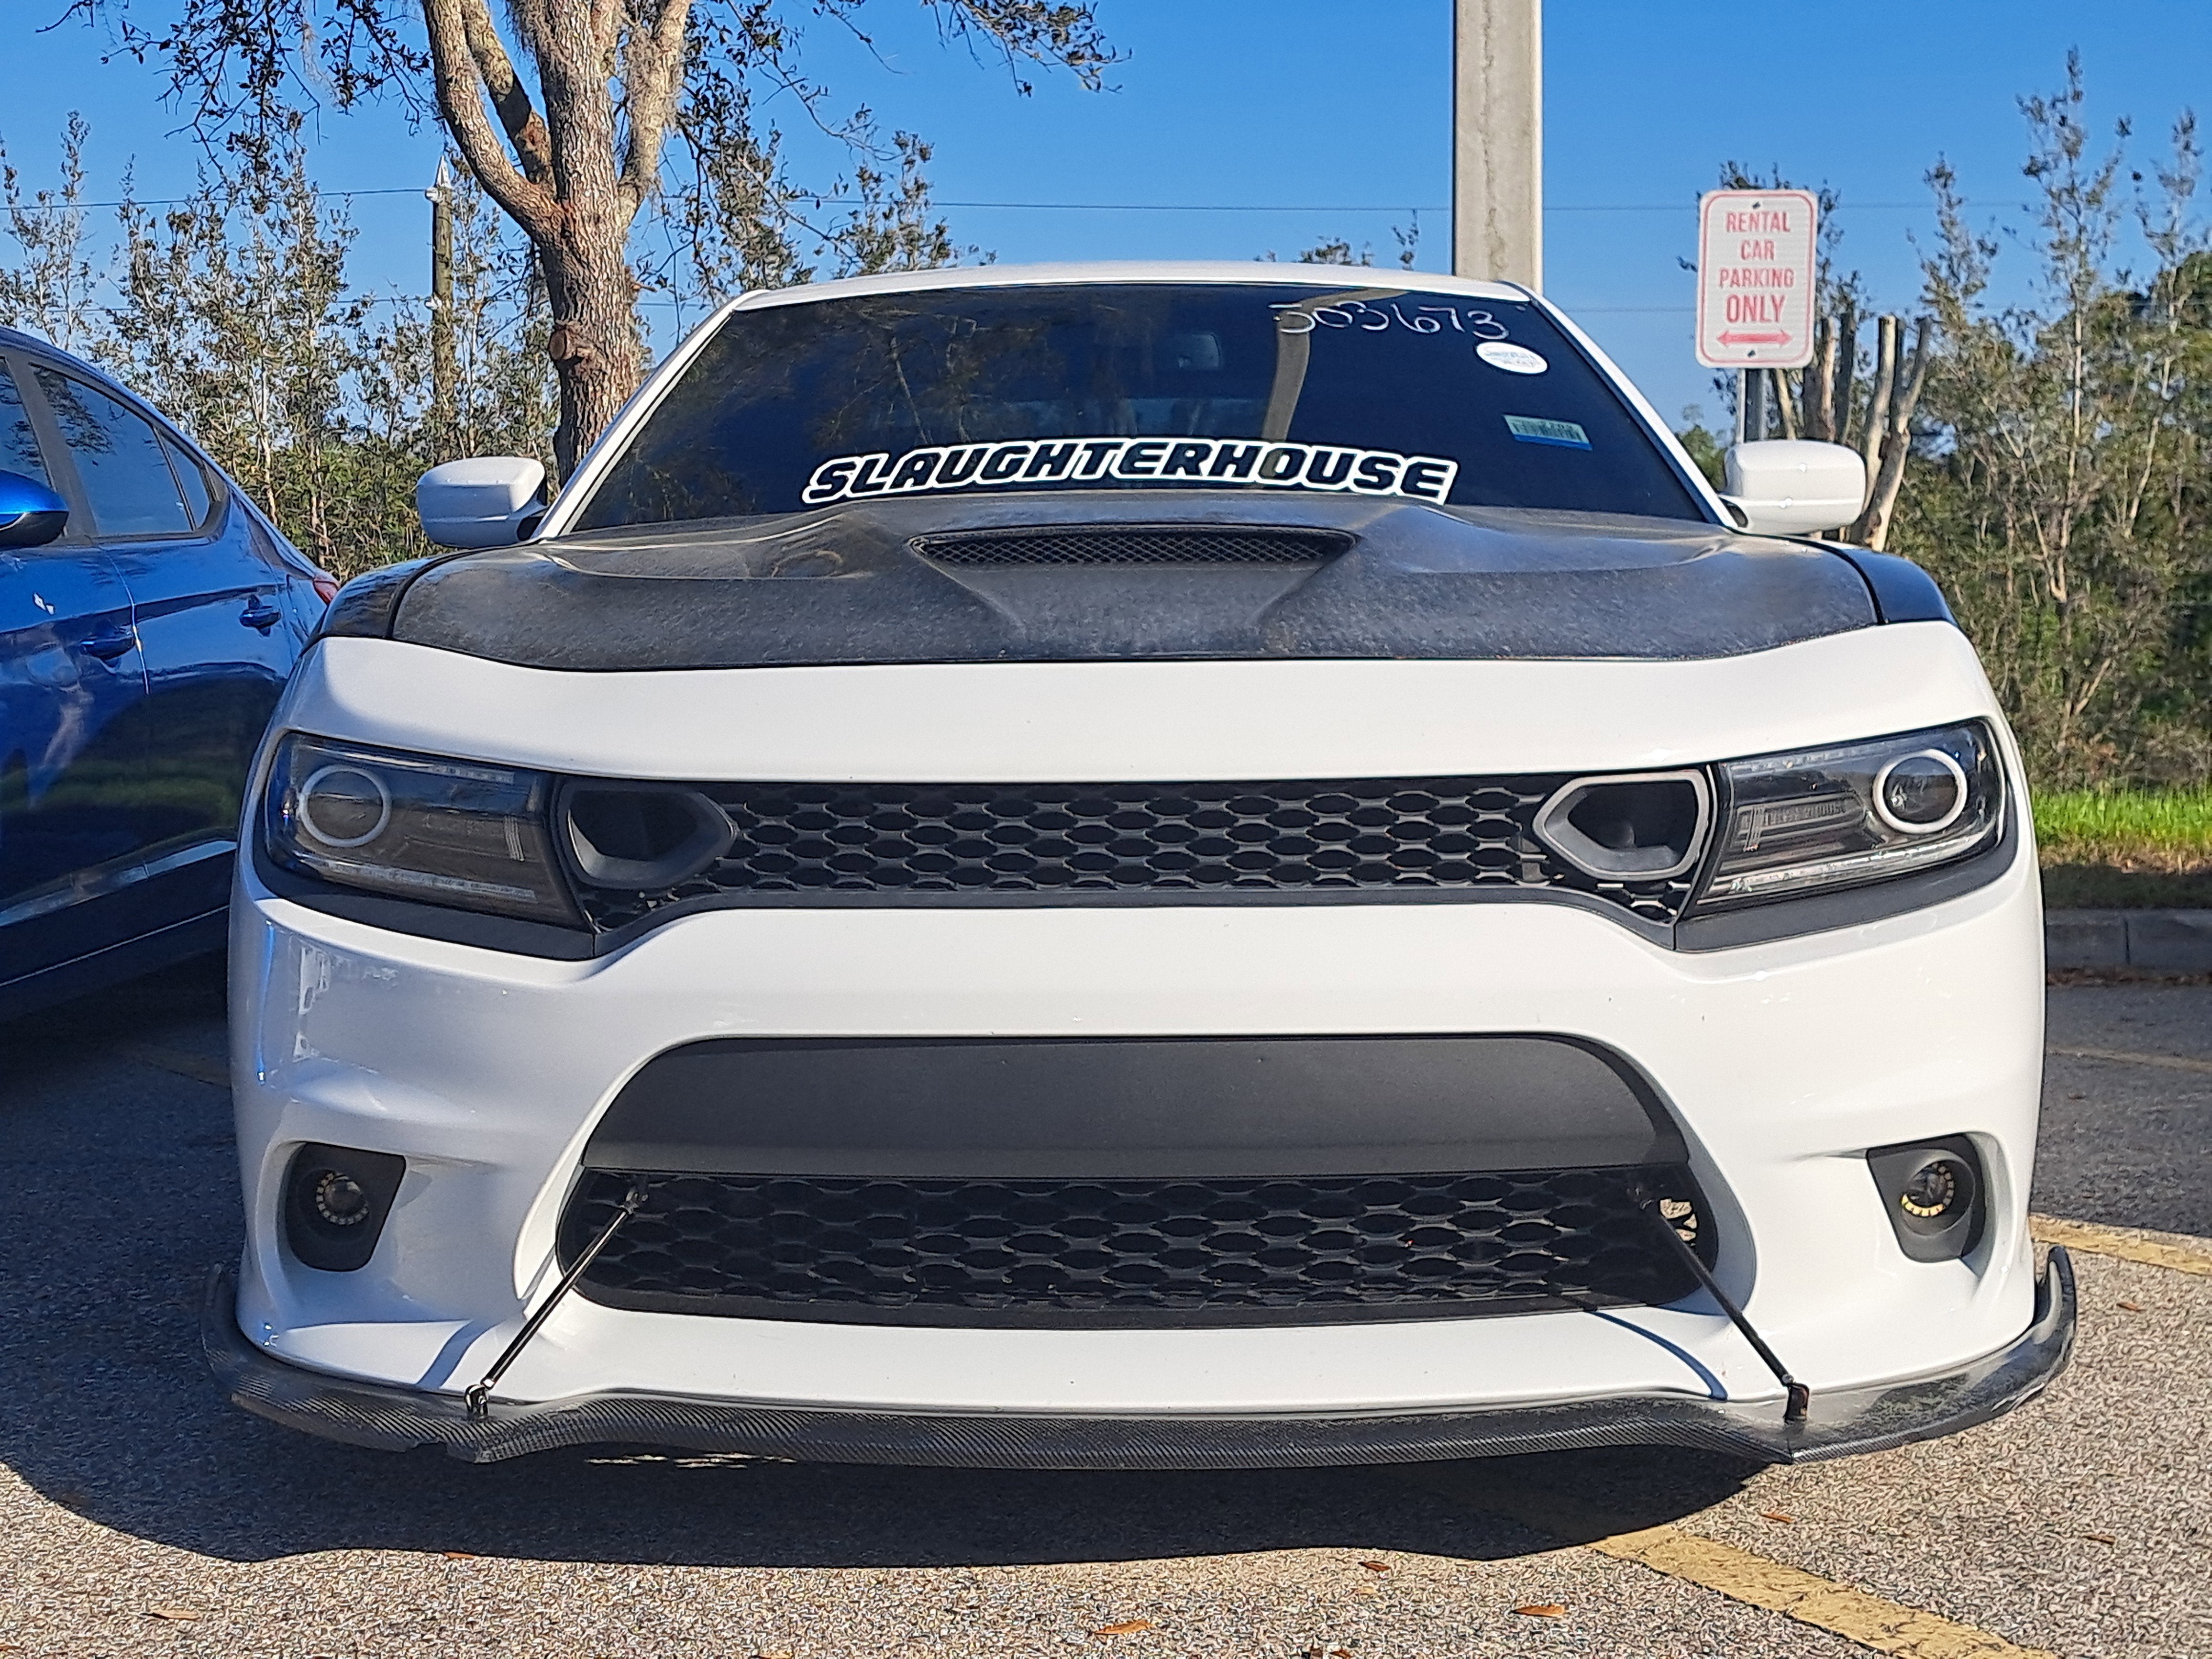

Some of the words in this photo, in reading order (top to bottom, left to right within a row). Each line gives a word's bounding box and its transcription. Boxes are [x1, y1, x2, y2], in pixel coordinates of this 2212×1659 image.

[1726, 211, 1791, 232] RENTAL
[1741, 239, 1774, 261] CAR
[1719, 268, 1794, 288] PARKING
[1726, 294, 1786, 323] ONLY
[802, 437, 1460, 506] SLAUGHTERHOUSE
